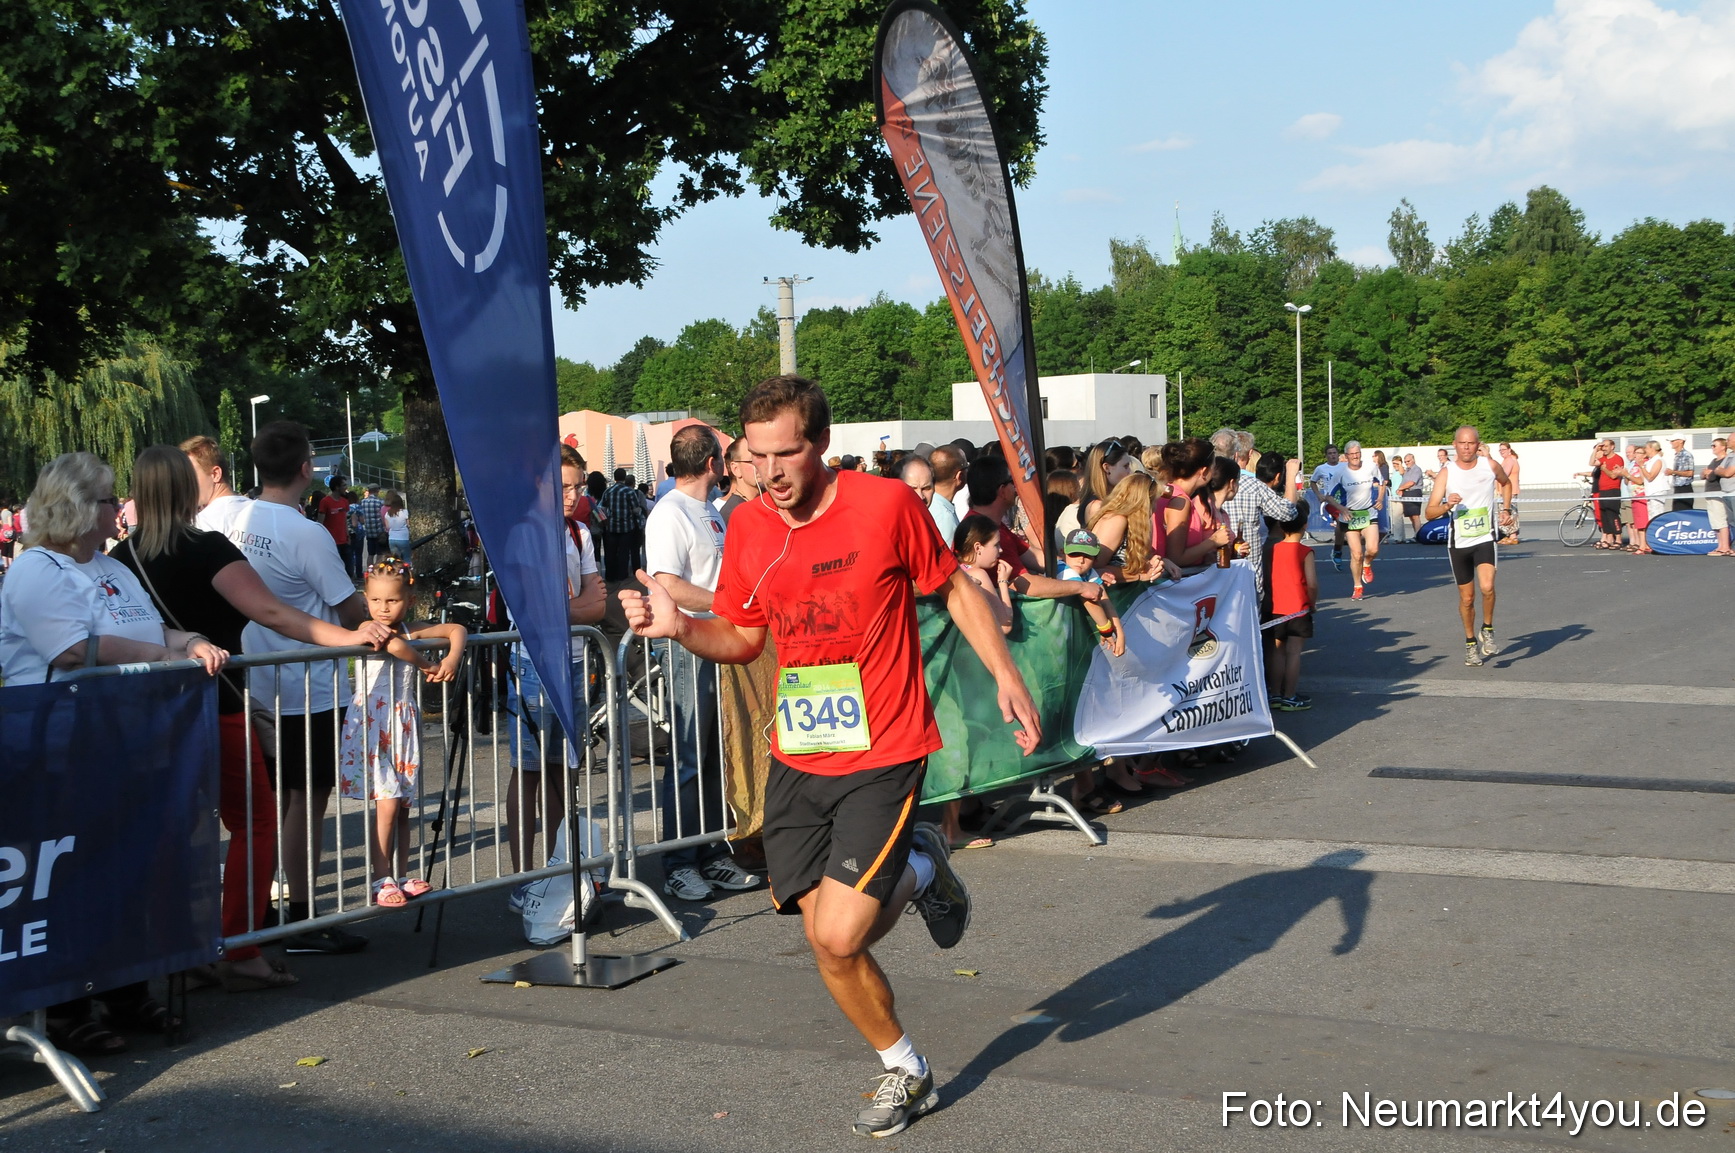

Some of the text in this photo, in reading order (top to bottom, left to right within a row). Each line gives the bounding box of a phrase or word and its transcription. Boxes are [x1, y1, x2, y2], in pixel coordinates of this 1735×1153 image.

[1463, 516, 1485, 531] 544
[228, 529, 272, 551] OLGER
[1667, 528, 1717, 541] Fische
[811, 557, 843, 574] swn
[1194, 643, 1213, 656] 1628
[1171, 664, 1242, 700] Neumarkter
[778, 695, 860, 732] 1349
